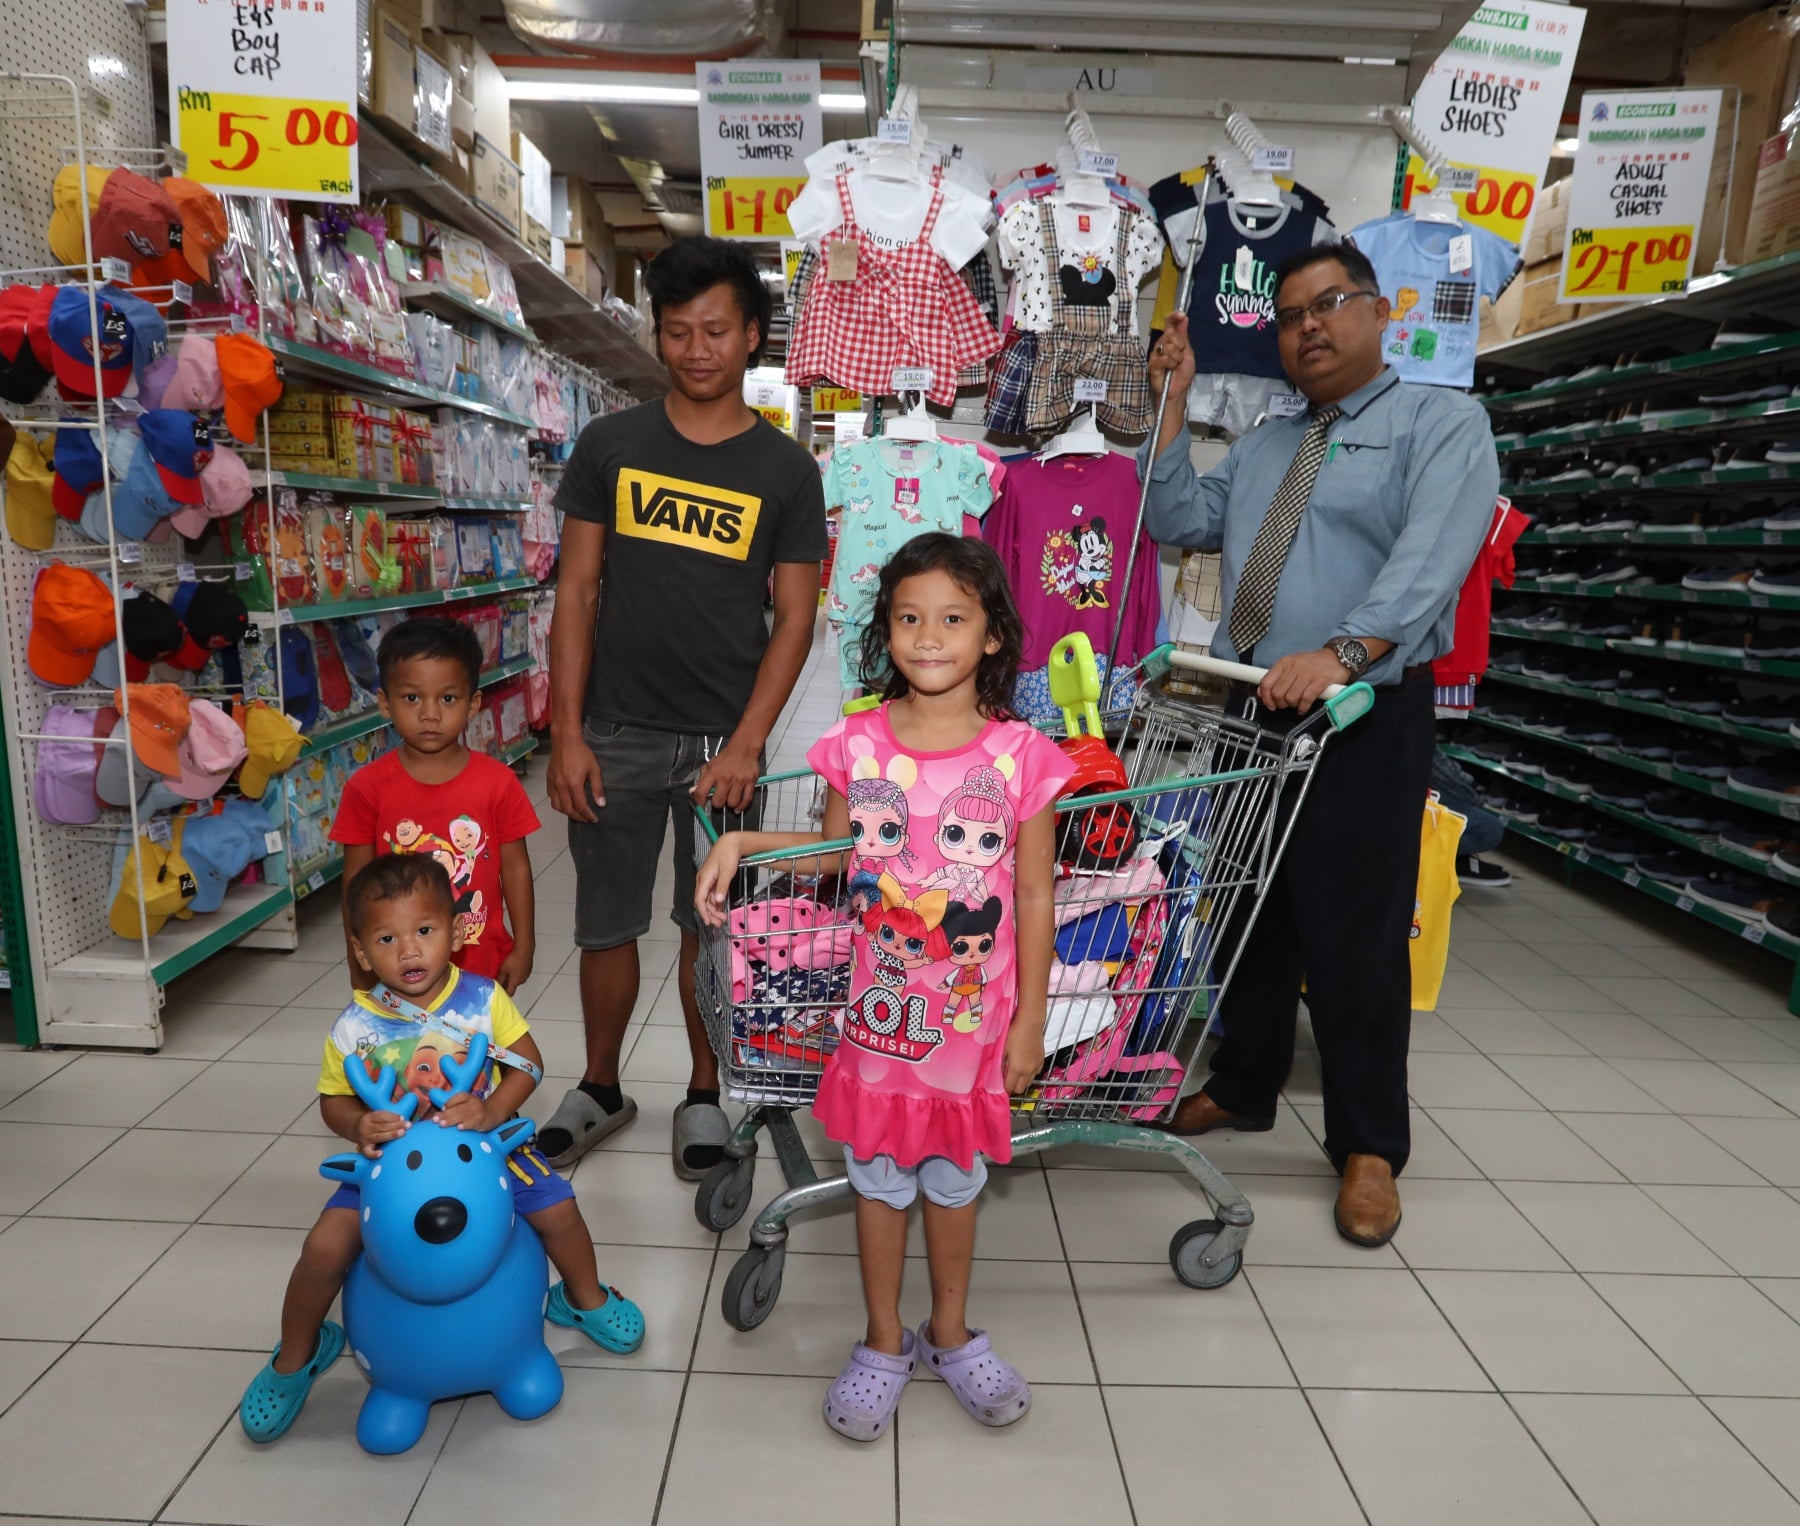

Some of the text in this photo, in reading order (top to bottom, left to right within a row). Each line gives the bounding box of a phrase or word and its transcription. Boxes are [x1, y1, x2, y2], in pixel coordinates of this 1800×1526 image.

[1473, 9, 1525, 28] ONSAVE
[231, 28, 279, 59] Boy
[1492, 40, 1532, 61] HARGA
[1534, 48, 1563, 66] KAMI
[234, 53, 281, 81] CAP
[1075, 68, 1116, 91] AU
[1450, 77, 1521, 112] LADIES
[1618, 103, 1674, 118] ECONSAVE
[718, 120, 751, 140] GIRL
[1440, 106, 1508, 138] SHOES
[1266, 150, 1287, 159] 19.00
[1615, 163, 1669, 181] ADULT
[319, 179, 354, 193] EACH
[1609, 183, 1668, 200] CASUAL
[1615, 200, 1663, 219] SHOES
[1219, 258, 1278, 299] Hllo
[1082, 381, 1103, 389] 22.00
[1282, 397, 1303, 406] 25.00
[630, 481, 745, 544] VANS
